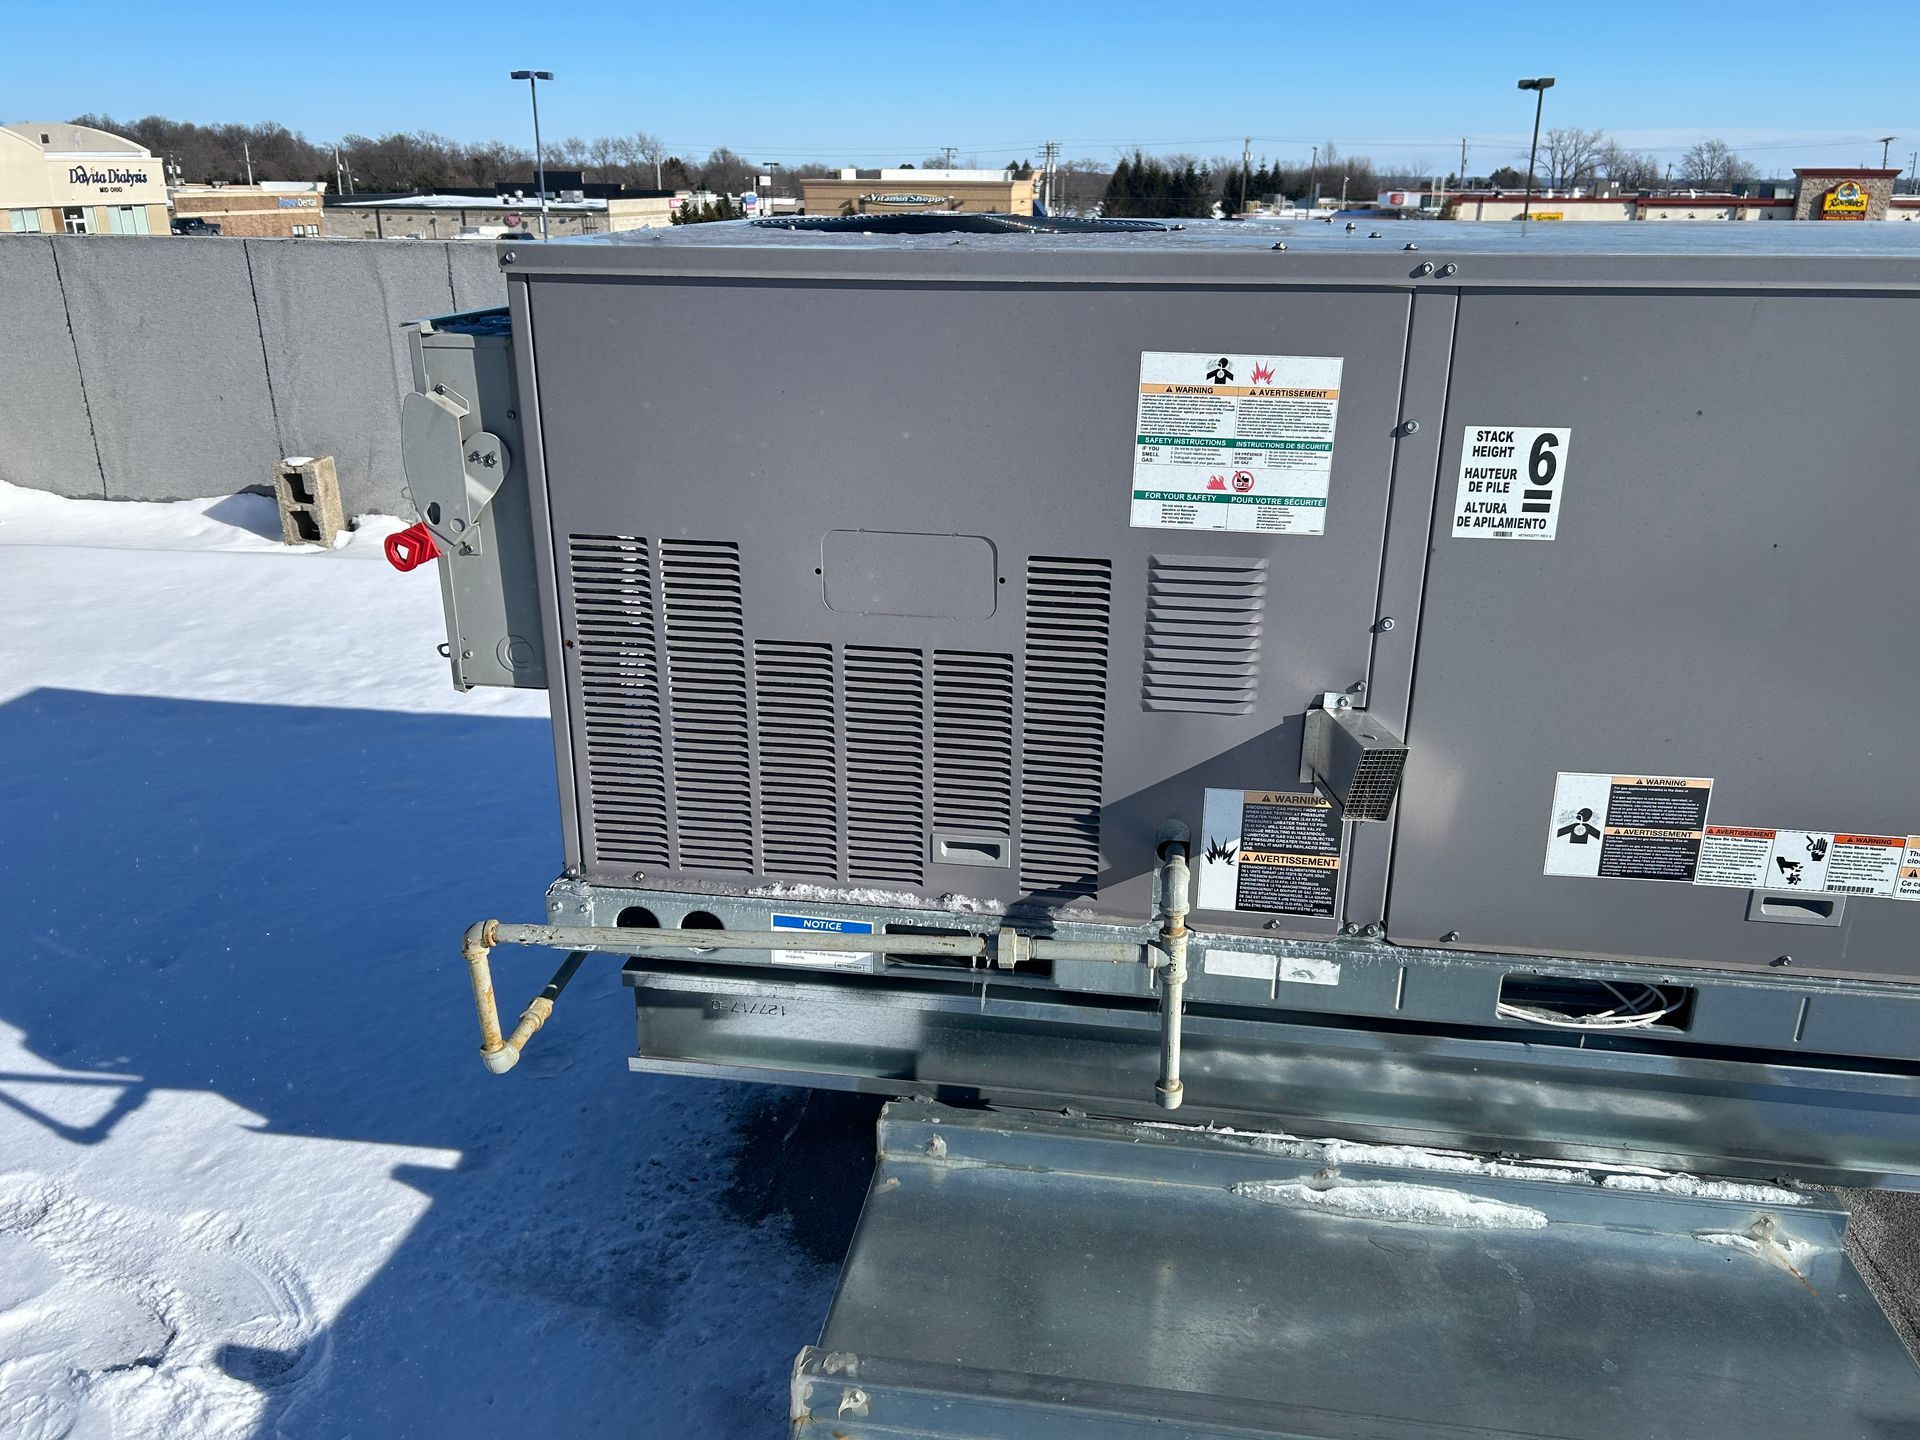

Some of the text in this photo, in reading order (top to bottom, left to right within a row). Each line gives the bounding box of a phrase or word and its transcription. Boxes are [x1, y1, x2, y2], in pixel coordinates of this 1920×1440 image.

[69, 165, 148, 186] DaVita Dialysis
[870, 192, 908, 202] Vitamin
[910, 194, 947, 204] Shoppe
[1176, 386, 1214, 394] WARNING
[1259, 389, 1327, 398] AVERTISSEMENT
[1174, 438, 1226, 446] INSTRUCTIONS
[1476, 431, 1515, 443] STACK
[1236, 441, 1285, 449] INSTRUCTIONS
[1296, 442, 1330, 450] SÉCURITÉ
[1472, 446, 1515, 458] HEIGHT
[1528, 433, 1559, 486] 6
[1464, 468, 1517, 480] HAUTEUR
[1468, 482, 1510, 493] DE PILE
[1163, 492, 1184, 500] YOUR
[1187, 494, 1217, 502] SAFETY
[1284, 498, 1323, 506] SÉCURITÉ
[1464, 502, 1507, 514] ALTURA
[1457, 516, 1547, 530] DE APILAMIENTO
[1275, 795, 1327, 805] WARNING
[1623, 829, 1693, 838] AVERTISSEMENT
[1715, 829, 1775, 838] AVERTISSEMENT
[1855, 837, 1893, 846] WARNING
[1254, 856, 1337, 867] AVERTISSEMENT
[803, 920, 842, 931] NOTICE
